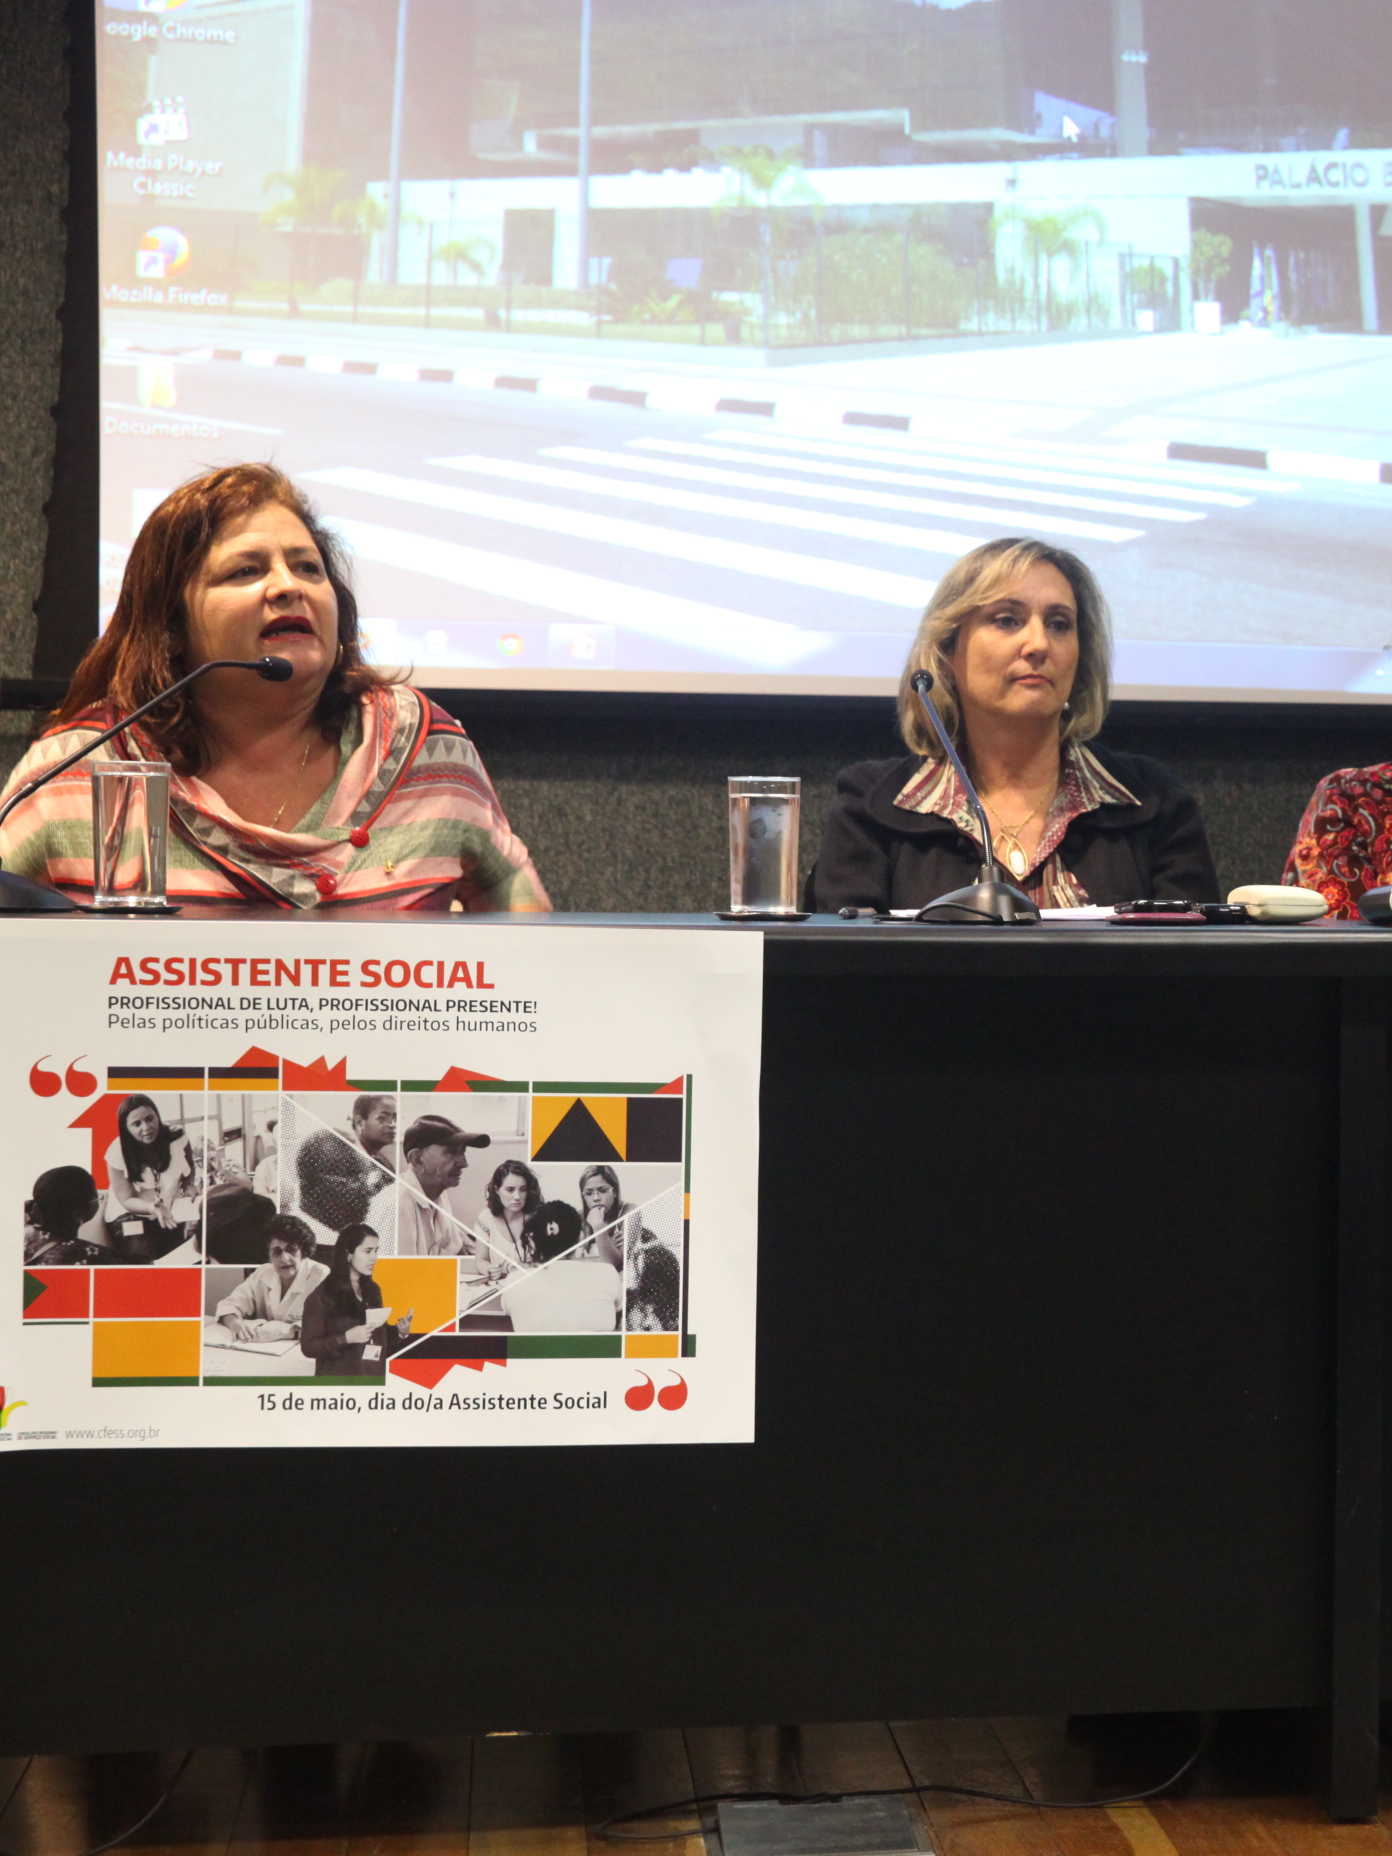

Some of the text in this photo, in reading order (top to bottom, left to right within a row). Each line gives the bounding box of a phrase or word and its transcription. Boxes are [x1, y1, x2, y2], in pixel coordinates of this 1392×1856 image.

[104, 20, 237, 43] oogle Chrome
[106, 150, 223, 177] Media Player
[1254, 157, 1370, 190] PALÁCIO
[132, 176, 196, 198] Classic
[167, 286, 229, 307] Firefox
[104, 416, 220, 441] Documentos
[108, 956, 495, 990] ASSISTENTE SOCIAL
[107, 995, 537, 1015] PROFISSIONAL DE LUTA, PROFISSIONAL PRESENTE!
[108, 1012, 537, 1035] Pelas políticas públicas, pelos direitos humanos
[257, 1390, 608, 1414] 15 de maio, dia do/a Assistente Social
[64, 1425, 161, 1442] www.cfess.org.br
